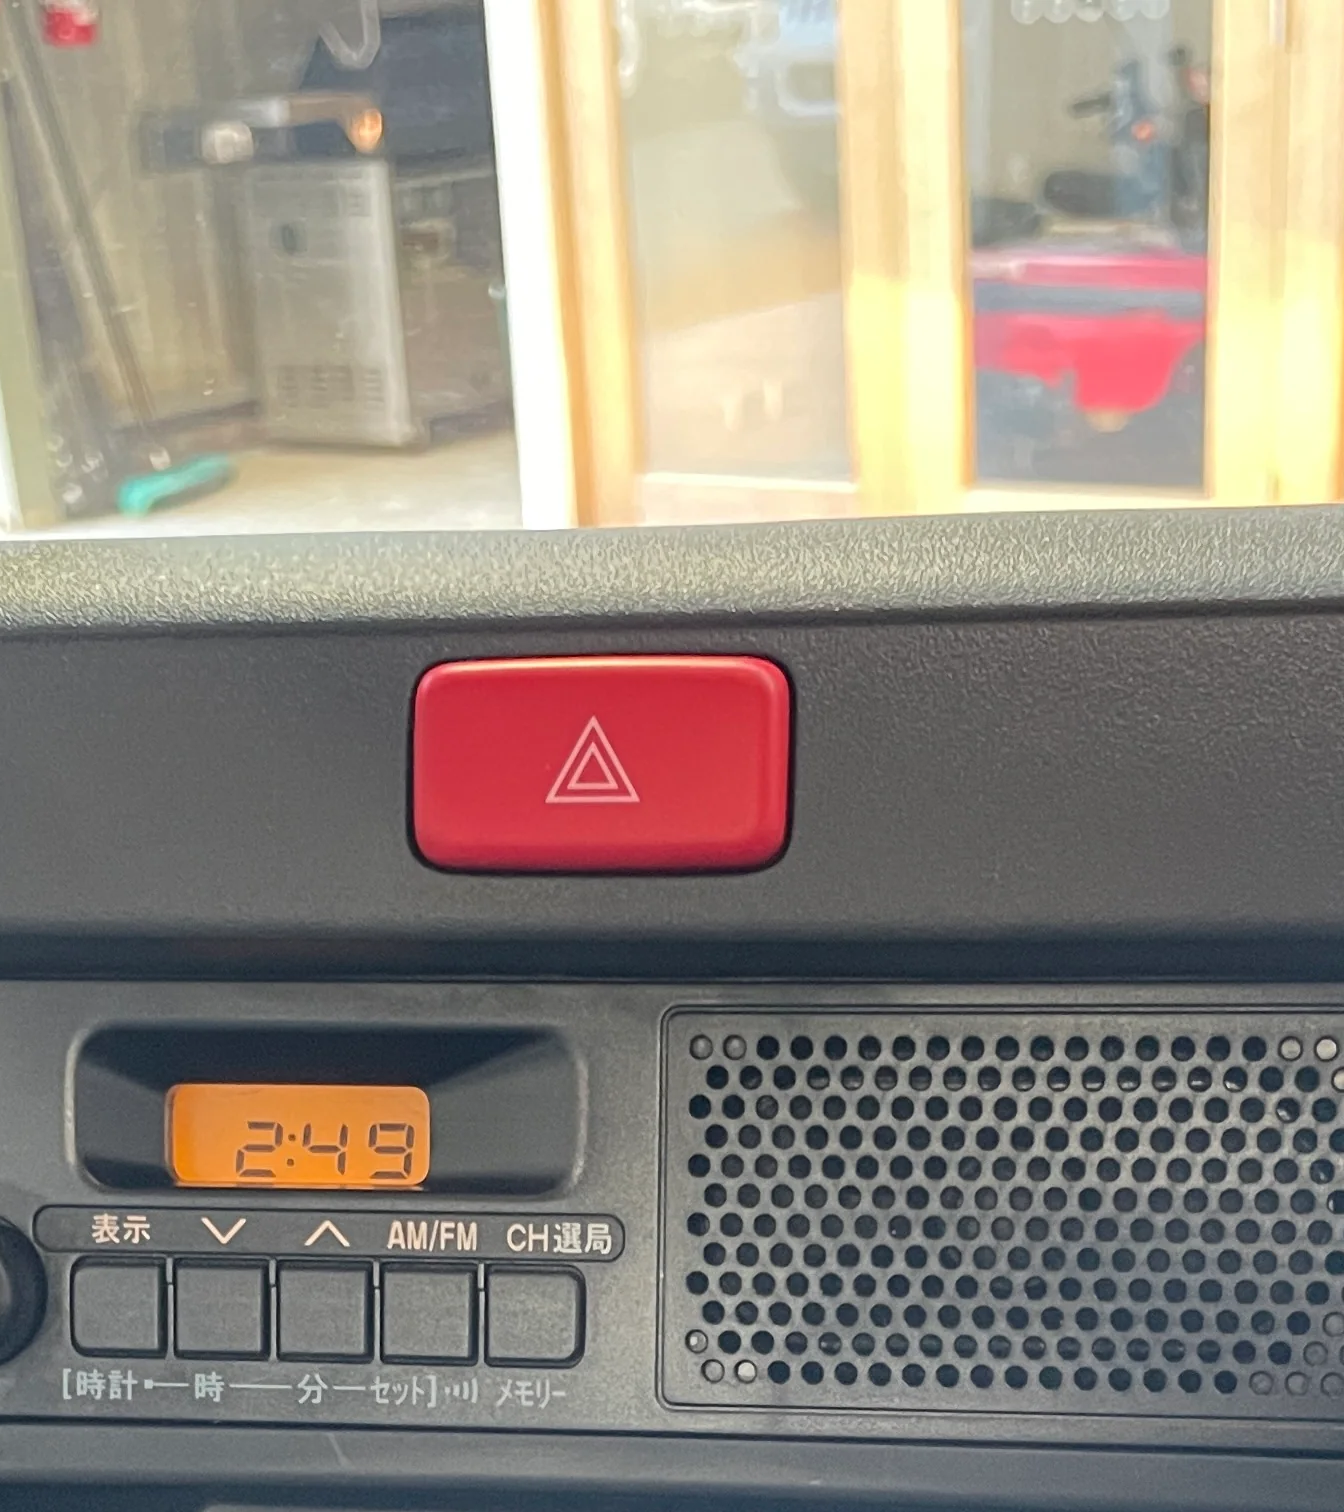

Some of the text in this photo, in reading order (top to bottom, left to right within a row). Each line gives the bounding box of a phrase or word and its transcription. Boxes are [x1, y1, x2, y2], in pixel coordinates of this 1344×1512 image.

[236, 1120, 415, 1180] 2:49
[91, 1213, 151, 1244] 表示
[386, 1219, 479, 1252] AM/FM
[194, 1371, 225, 1403] 時
[296, 1373, 328, 1405] 分
[496, 1378, 566, 1409] メモリー
